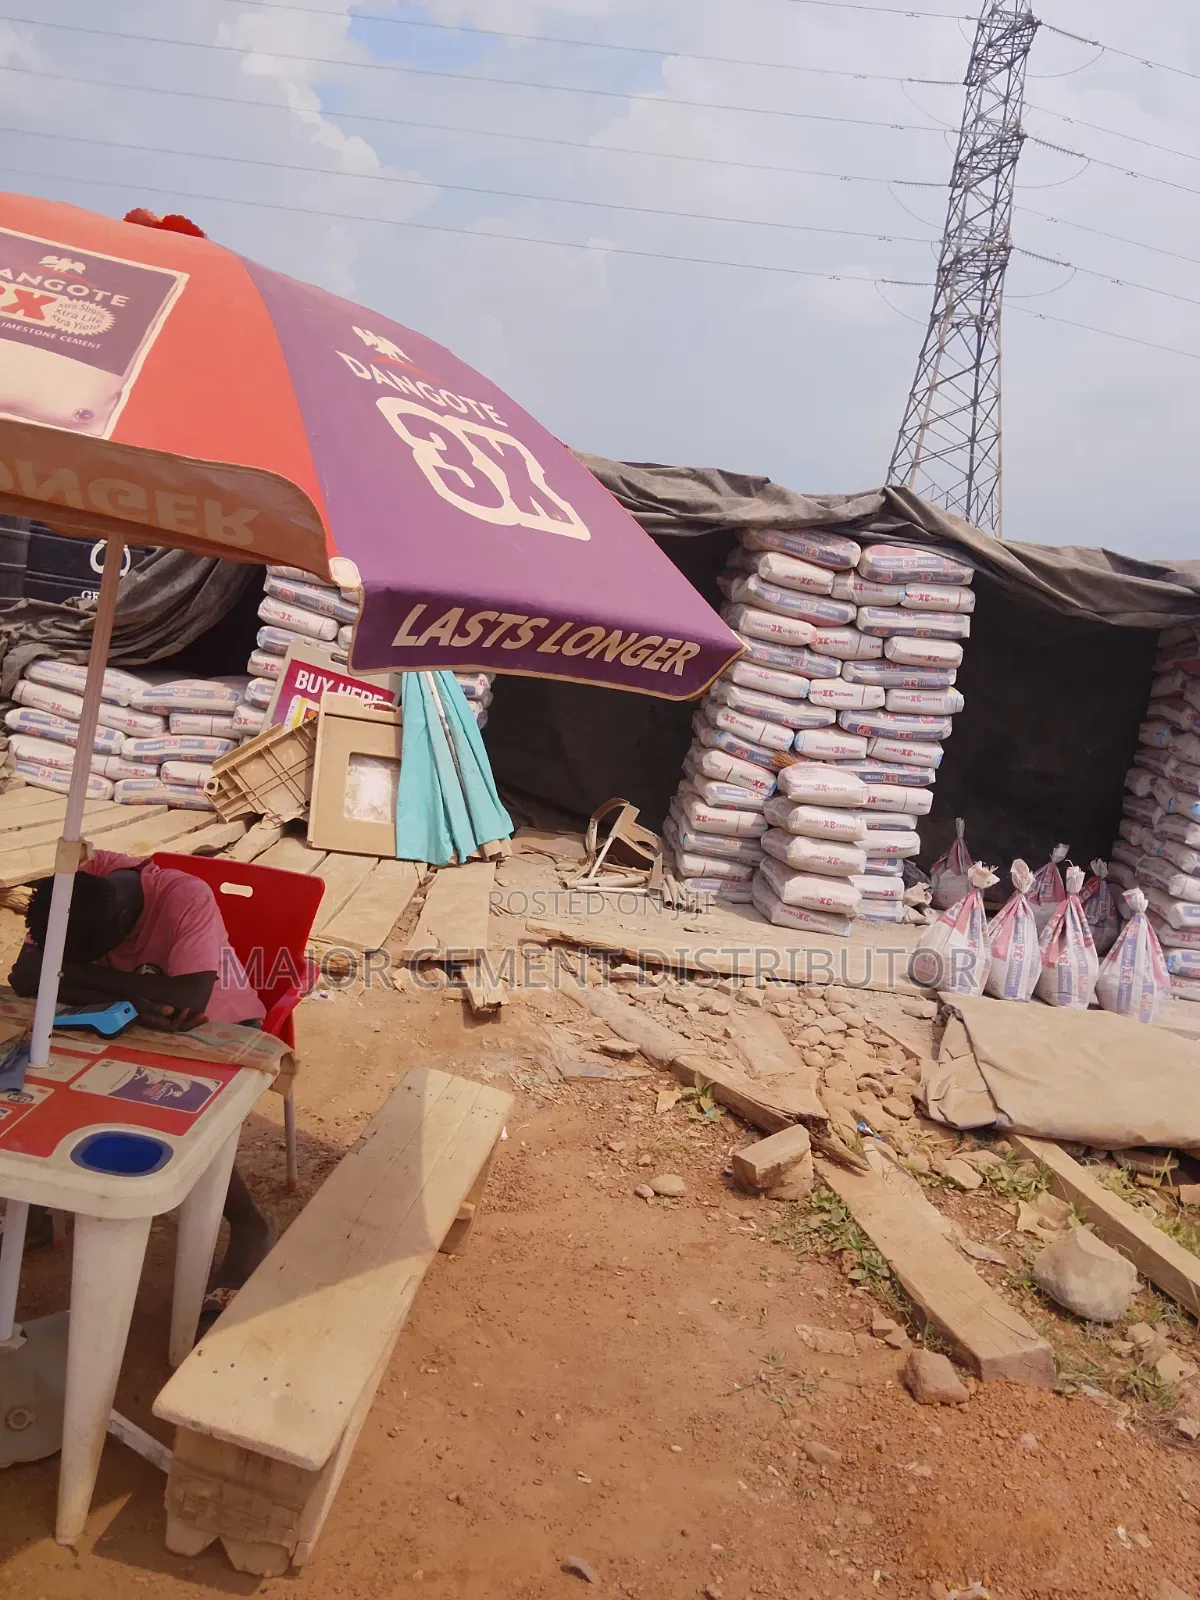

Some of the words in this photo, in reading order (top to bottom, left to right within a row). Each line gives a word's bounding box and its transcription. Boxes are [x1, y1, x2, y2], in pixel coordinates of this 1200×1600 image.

[0, 268, 130, 307] ANGOTE
[60, 336, 102, 350] CEMENT
[336, 350, 509, 427] DANGOTE
[392, 604, 548, 651] LASTS
[536, 620, 701, 677] LONGER
[294, 669, 335, 695] BUY
